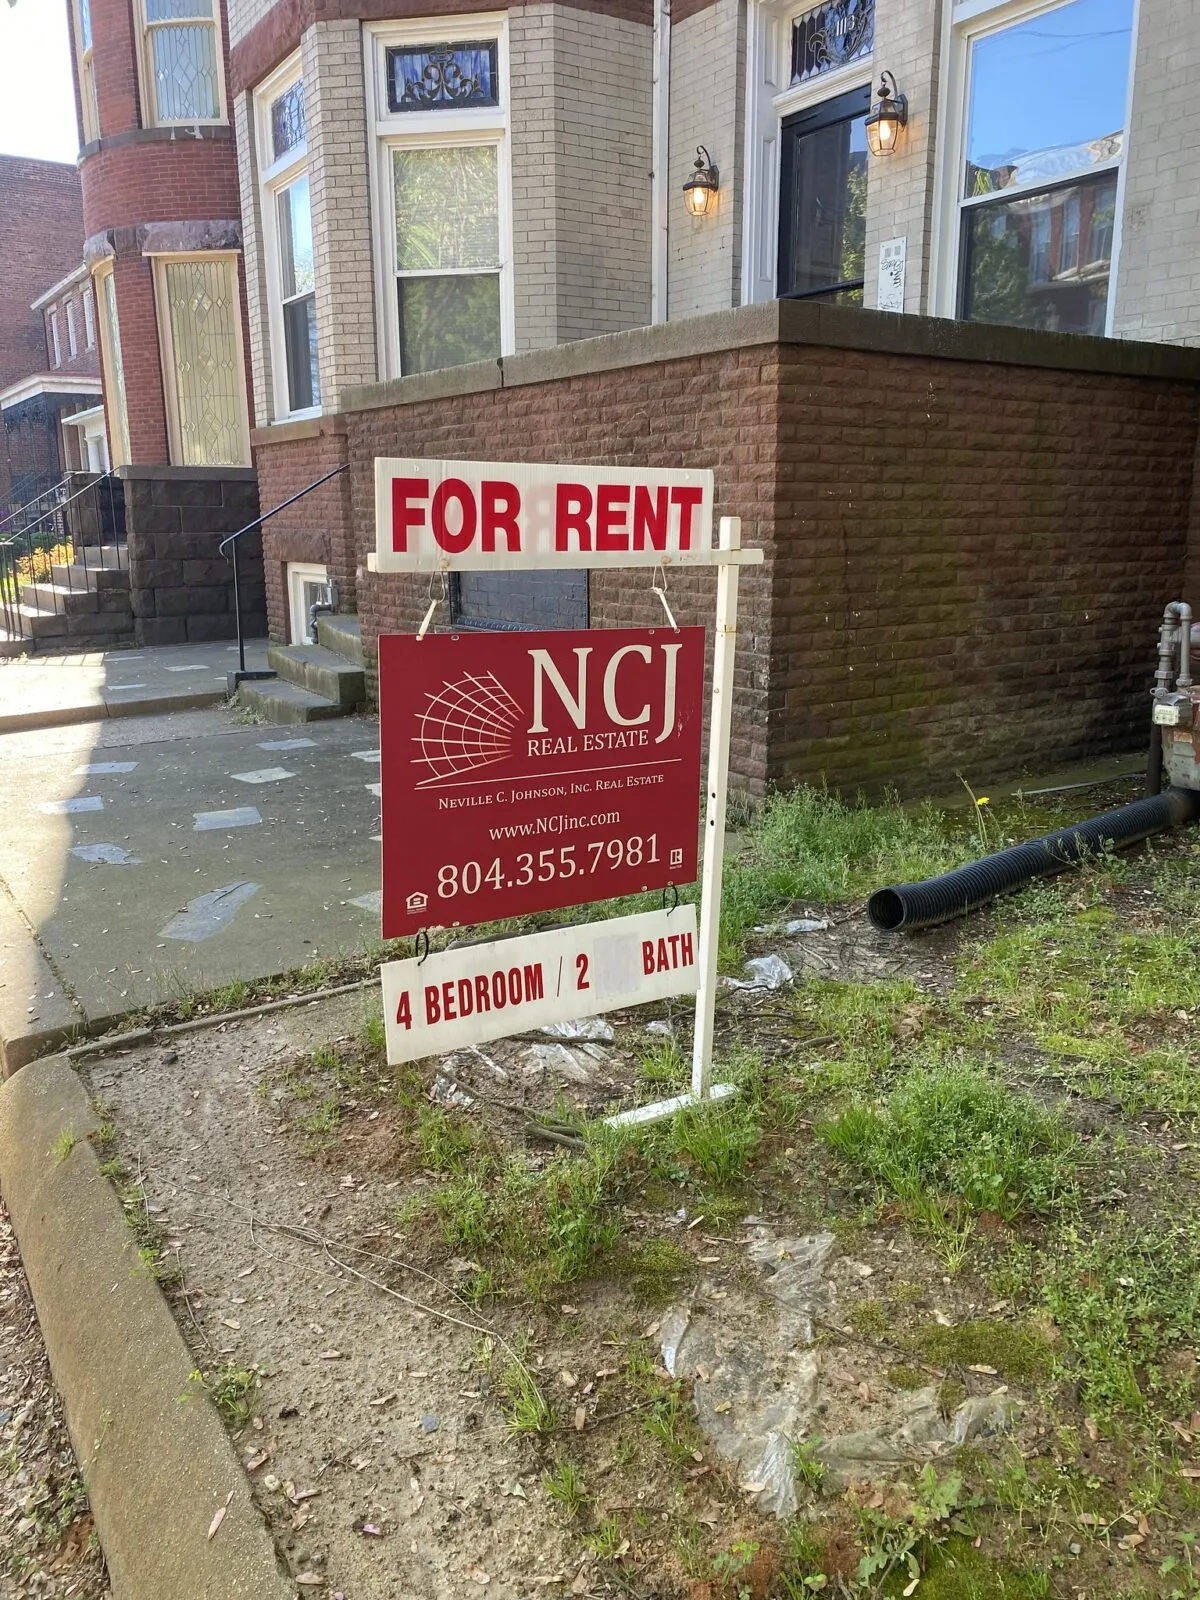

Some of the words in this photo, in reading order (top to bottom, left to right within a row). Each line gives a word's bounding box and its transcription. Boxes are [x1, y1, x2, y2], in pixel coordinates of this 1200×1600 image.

[391, 477, 522, 554] FOR
[555, 483, 704, 553] RENT
[527, 643, 683, 745] NCJ
[527, 736, 578, 757] REAL
[583, 729, 649, 752] ESTATE
[489, 811, 621, 842] www.NCJinc.com
[496, 791, 508, 803] C.
[437, 833, 661, 899] 804.355.7981
[396, 991, 412, 1030] 4
[424, 963, 544, 1025] BEDROOM
[575, 953, 590, 990] 2
[642, 932, 694, 976] BATH
